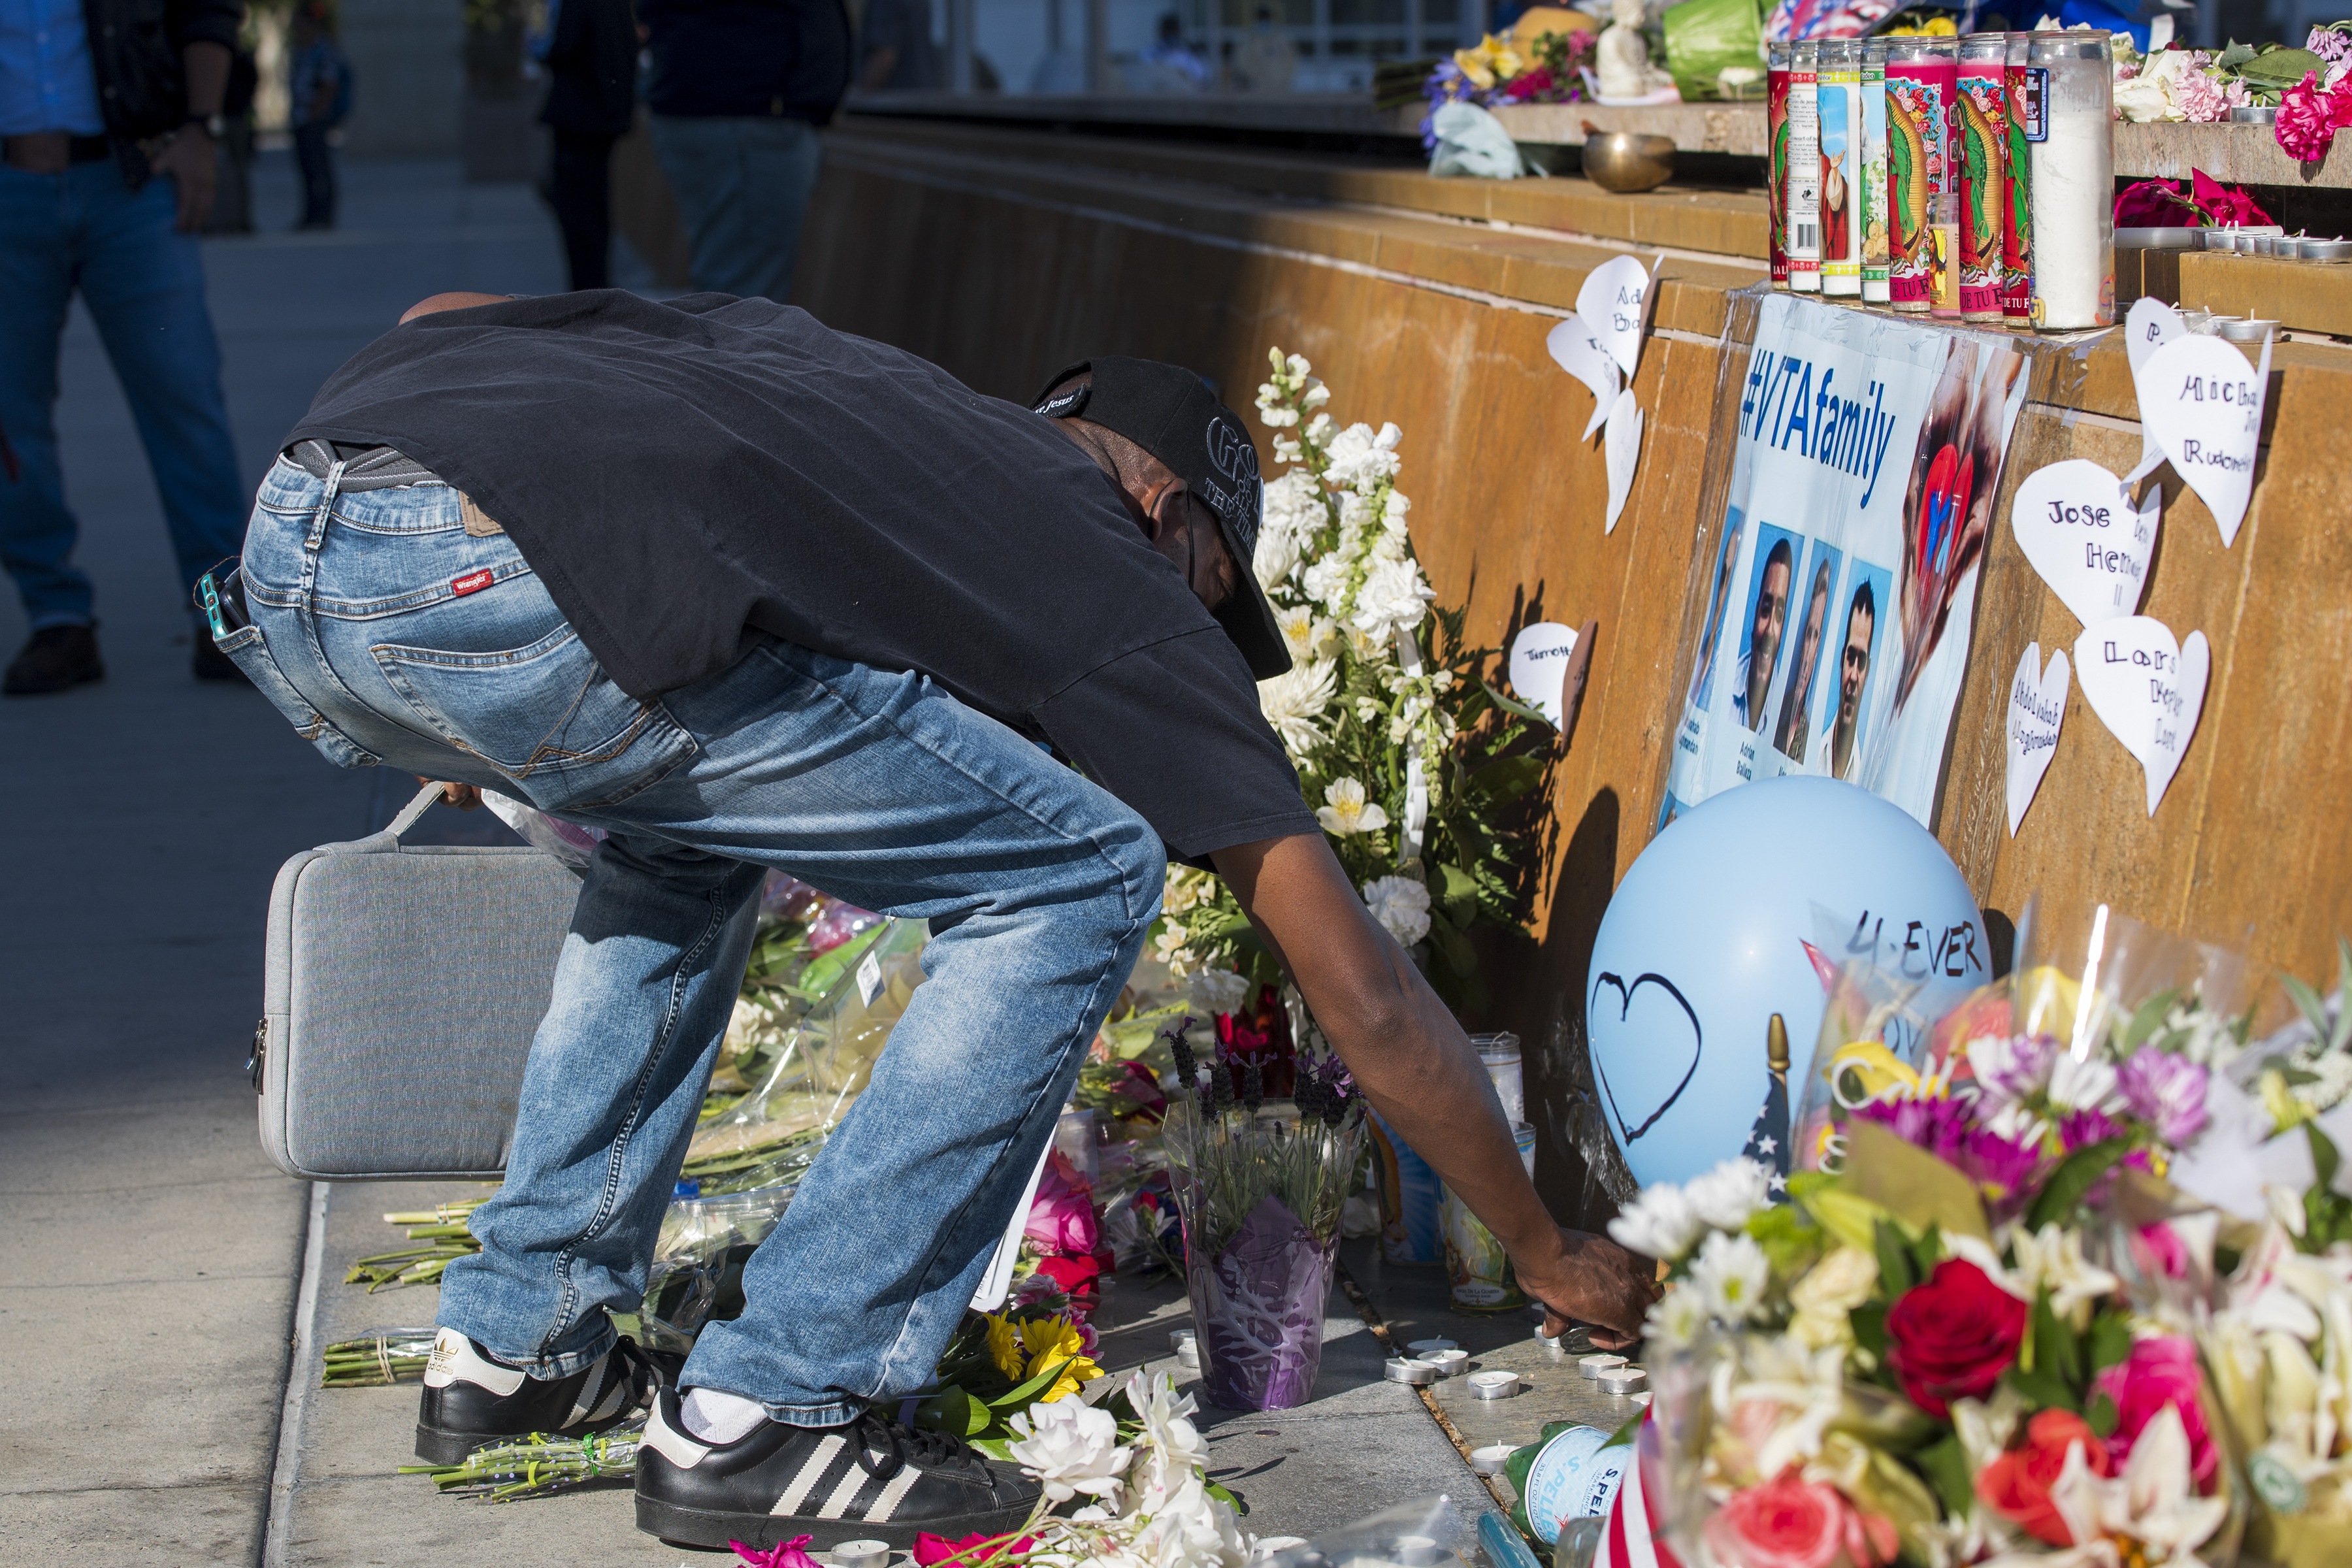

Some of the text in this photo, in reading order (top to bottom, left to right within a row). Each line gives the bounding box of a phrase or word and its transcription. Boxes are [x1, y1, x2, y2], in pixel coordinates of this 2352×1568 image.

[1891, 282, 1899, 298] DE
[1900, 281, 1916, 297] TU
[1961, 293, 1972, 308] DE
[1973, 290, 1990, 308] TU
[2012, 298, 2022, 308] TU
[1043, 395, 1074, 414] Jesus
[1740, 348, 1896, 510] #VTAfamily
[1204, 477, 1235, 519] THE
[1232, 491, 1250, 517] ALL
[2048, 500, 2110, 528] Jose
[457, 575, 485, 590] Wrangler
[2104, 641, 2176, 675] Lars
[1740, 741, 1755, 762] Adrian
[1736, 760, 1752, 782] Balleza
[428, 1362, 453, 1375] adidas
[1536, 1463, 1546, 1478] 33.8
[1533, 1478, 1540, 1488] FL
[1582, 1472, 1603, 1510] SPARKLING
[1589, 1468, 1618, 1518] S.PEL
[1531, 1488, 1538, 1501] OZ
